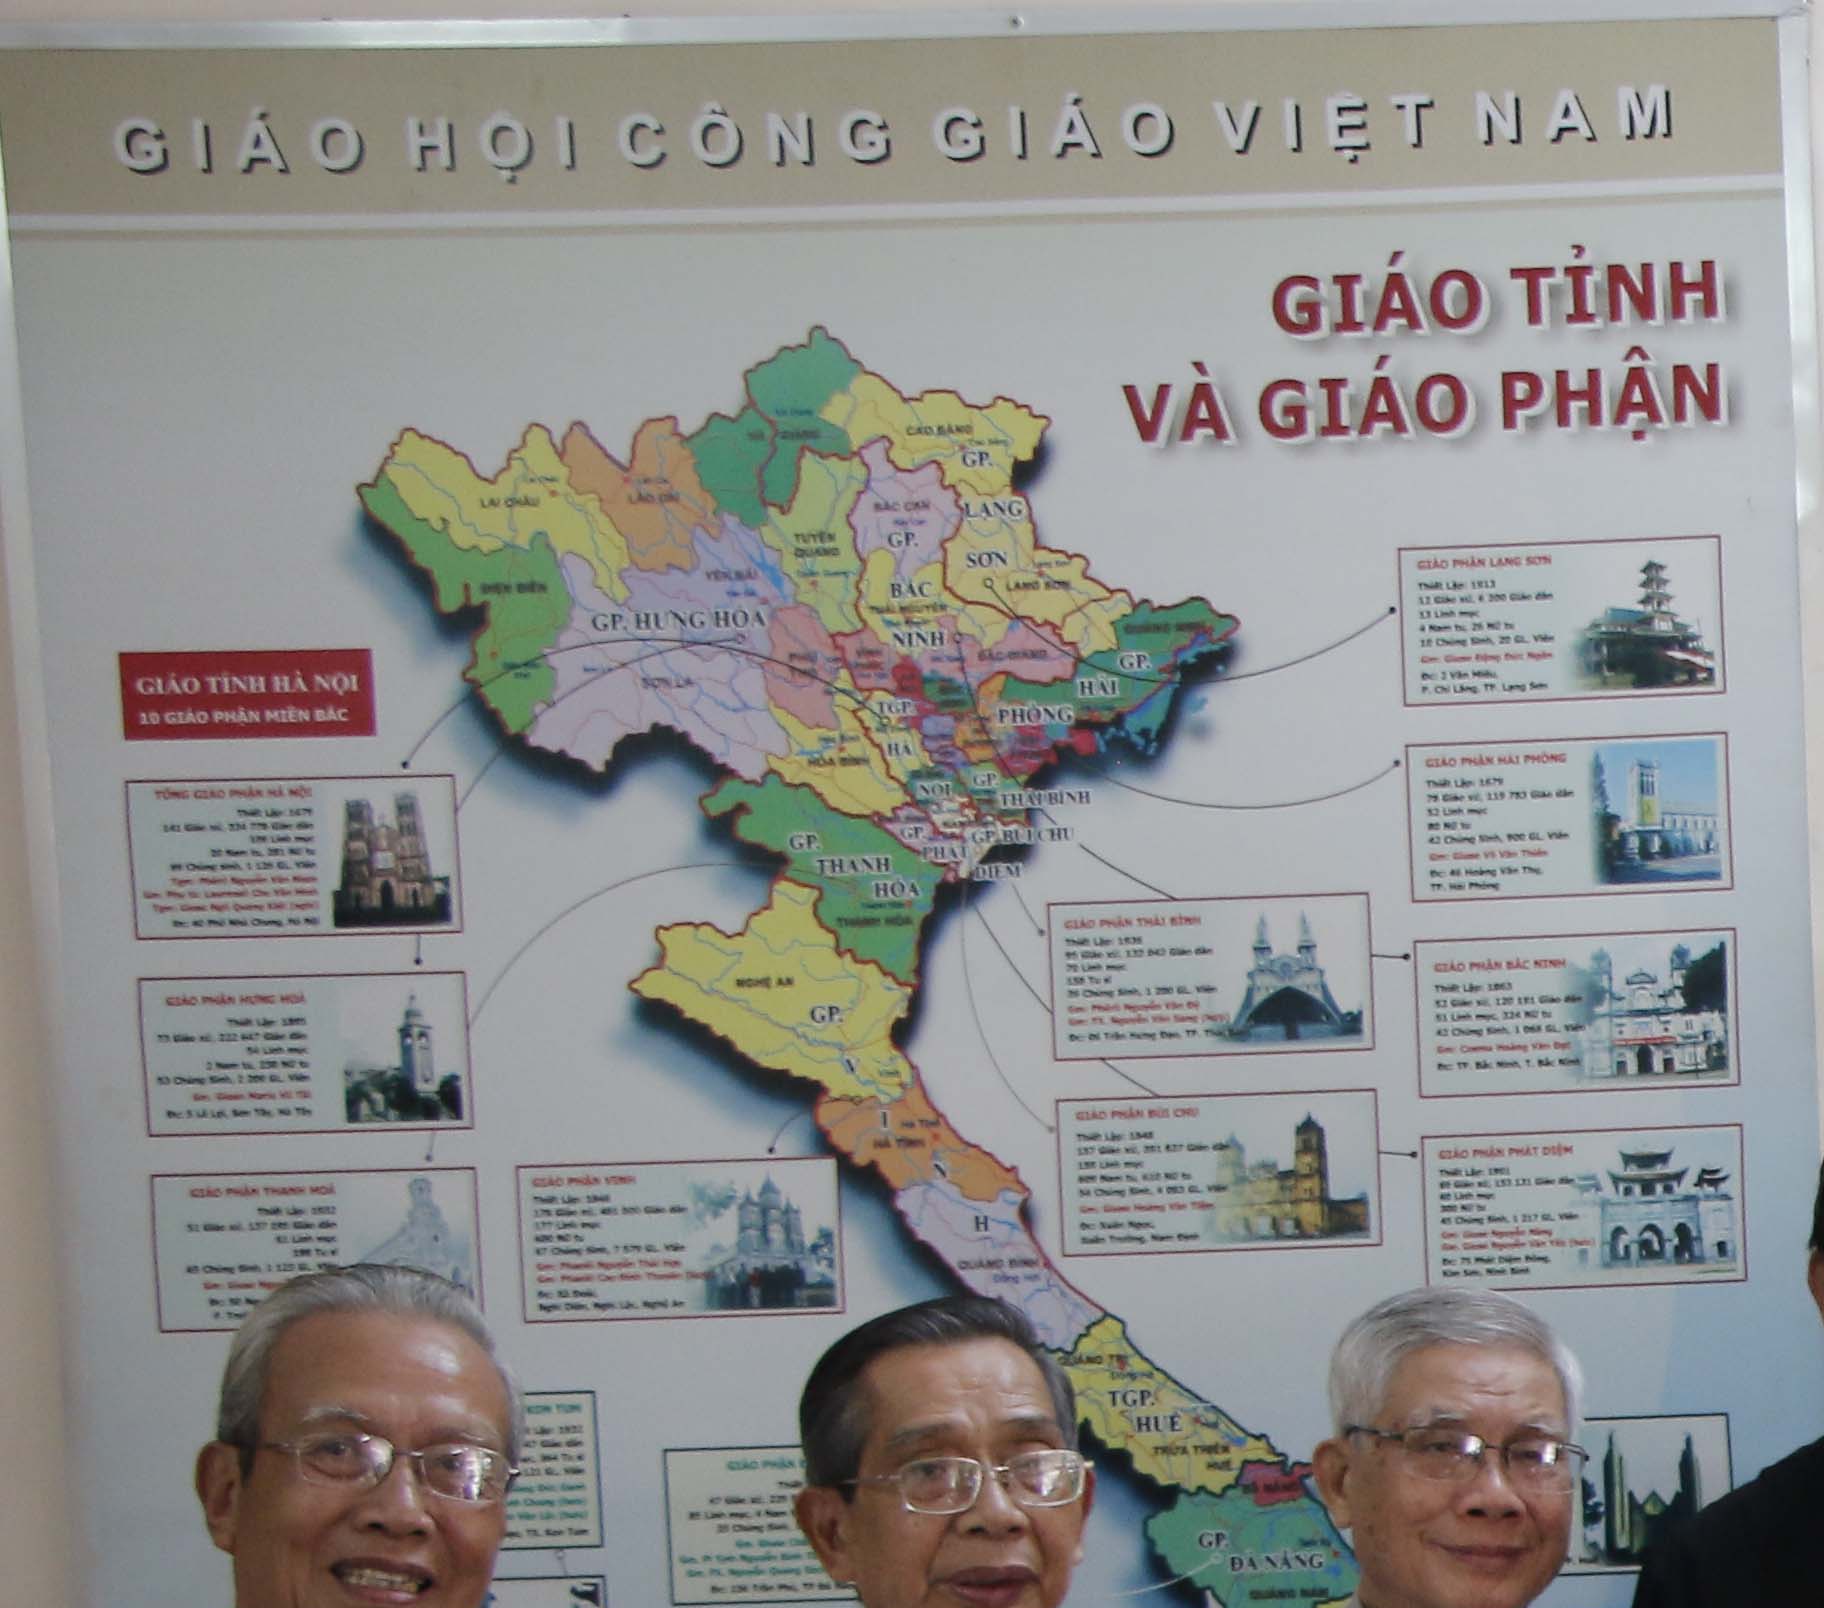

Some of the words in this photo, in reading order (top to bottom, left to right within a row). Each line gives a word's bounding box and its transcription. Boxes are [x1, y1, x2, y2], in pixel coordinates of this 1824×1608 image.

[113, 106, 367, 175] GIÁO
[405, 110, 578, 182] HỘI
[616, 102, 895, 170] CÔNG
[932, 93, 1176, 161] GIÁO
[1213, 94, 1435, 163] VIỆT
[1476, 84, 1674, 146] NAM
[1271, 252, 1487, 337] GIÁO
[1510, 245, 1725, 326] TỈNH
[1121, 361, 1234, 446] VÀ
[1257, 355, 1484, 441] GIÁO
[1501, 346, 1725, 441] PHẬN
[961, 451, 993, 468] GP.
[887, 530, 919, 549] GP.
[590, 613, 630, 634] GP.
[893, 629, 946, 649] NINH
[1119, 653, 1151, 671] GP.
[135, 672, 201, 696] GIÁO
[204, 671, 267, 695] TỈNH
[271, 670, 308, 693] HÀ
[314, 671, 360, 696] NỘI
[139, 711, 160, 726] 10
[164, 708, 208, 726] GIÁO
[213, 708, 261, 728] PHẬN
[264, 704, 310, 724] MIỀN
[315, 705, 349, 723] BẮC
[788, 831, 821, 852] GP.
[816, 855, 892, 876] THANH
[810, 1004, 844, 1026] GP.
[1107, 1389, 1157, 1408] TGP.
[1198, 1530, 1230, 1550] GP.
